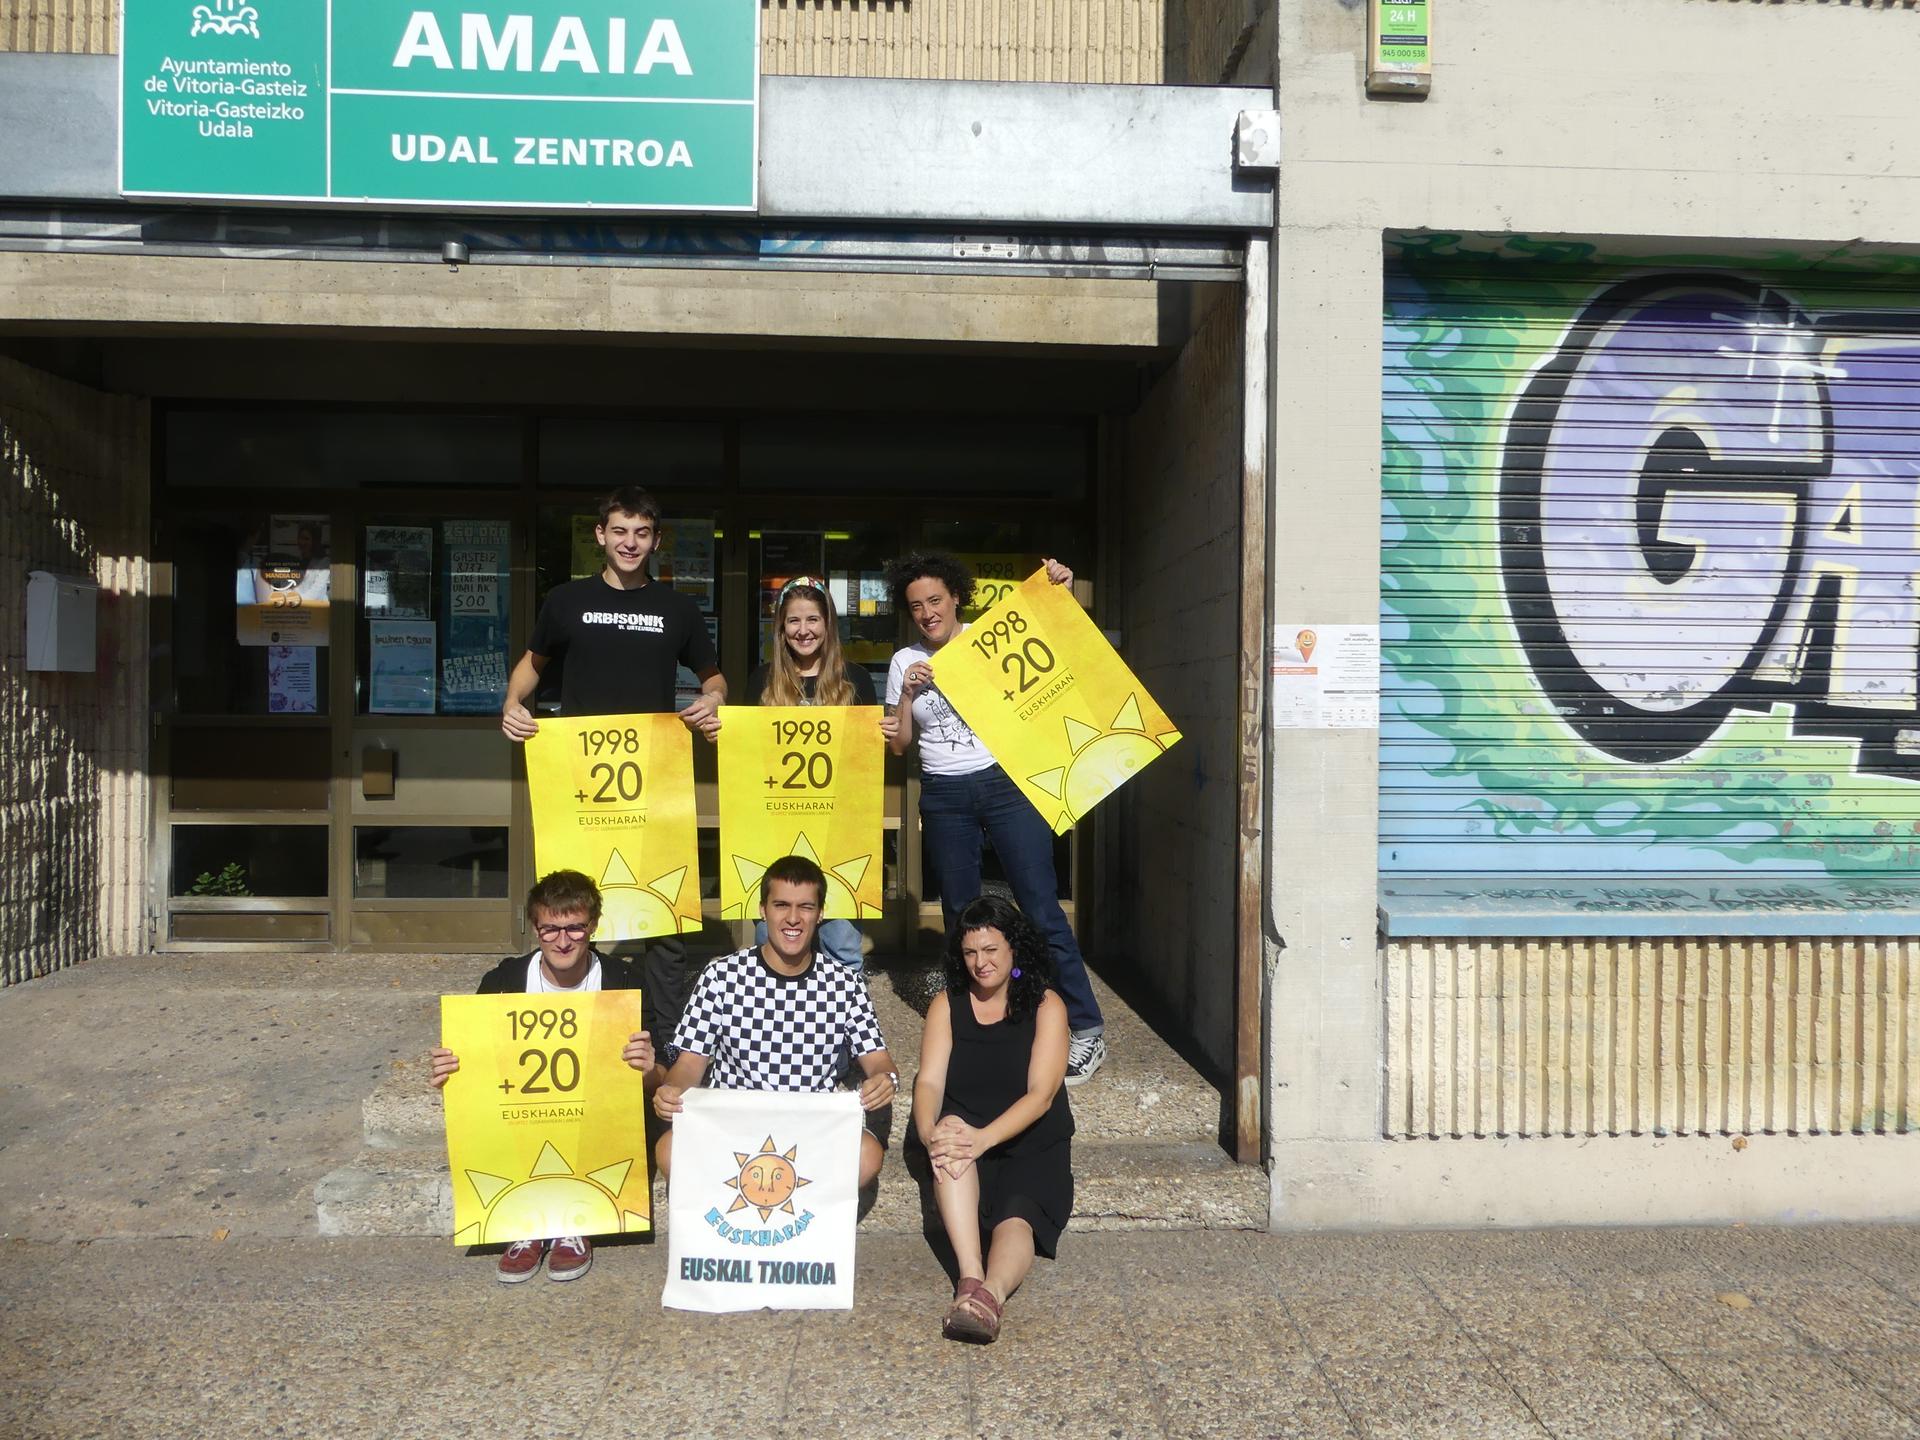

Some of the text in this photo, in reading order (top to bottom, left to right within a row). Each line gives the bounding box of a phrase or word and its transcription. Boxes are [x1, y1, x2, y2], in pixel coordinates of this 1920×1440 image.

[1390, 10, 1416, 22] 24 H
[393, 10, 693, 76] AMAIA
[1382, 49, 1426, 58] 945 000 538
[160, 57, 291, 79] Ayuntamiento
[144, 78, 307, 98] de Vitoria-Gasteiz
[147, 100, 304, 120] Vitoria-Gasteizko
[200, 121, 253, 139] Udala
[392, 134, 693, 168] UDAL ZENTROA
[976, 562, 1015, 579] 1998
[582, 612, 664, 628] ORBISONIK
[971, 610, 1028, 661] 1998
[1019, 674, 1074, 721] EUSKHARAN
[578, 729, 640, 757] 1998
[772, 720, 832, 746] 1998
[574, 761, 643, 804] +20
[763, 752, 834, 790] +20
[766, 802, 834, 811] EUSKHARAN
[578, 814, 647, 826] EUSKHARAN
[506, 1009, 578, 1041] 1998
[498, 1048, 580, 1094] +20
[502, 1107, 584, 1120] EUSKHARAN
[704, 1207, 815, 1247] EUSKHARAN
[680, 1257, 837, 1285] EUSKAL TXOKOA
